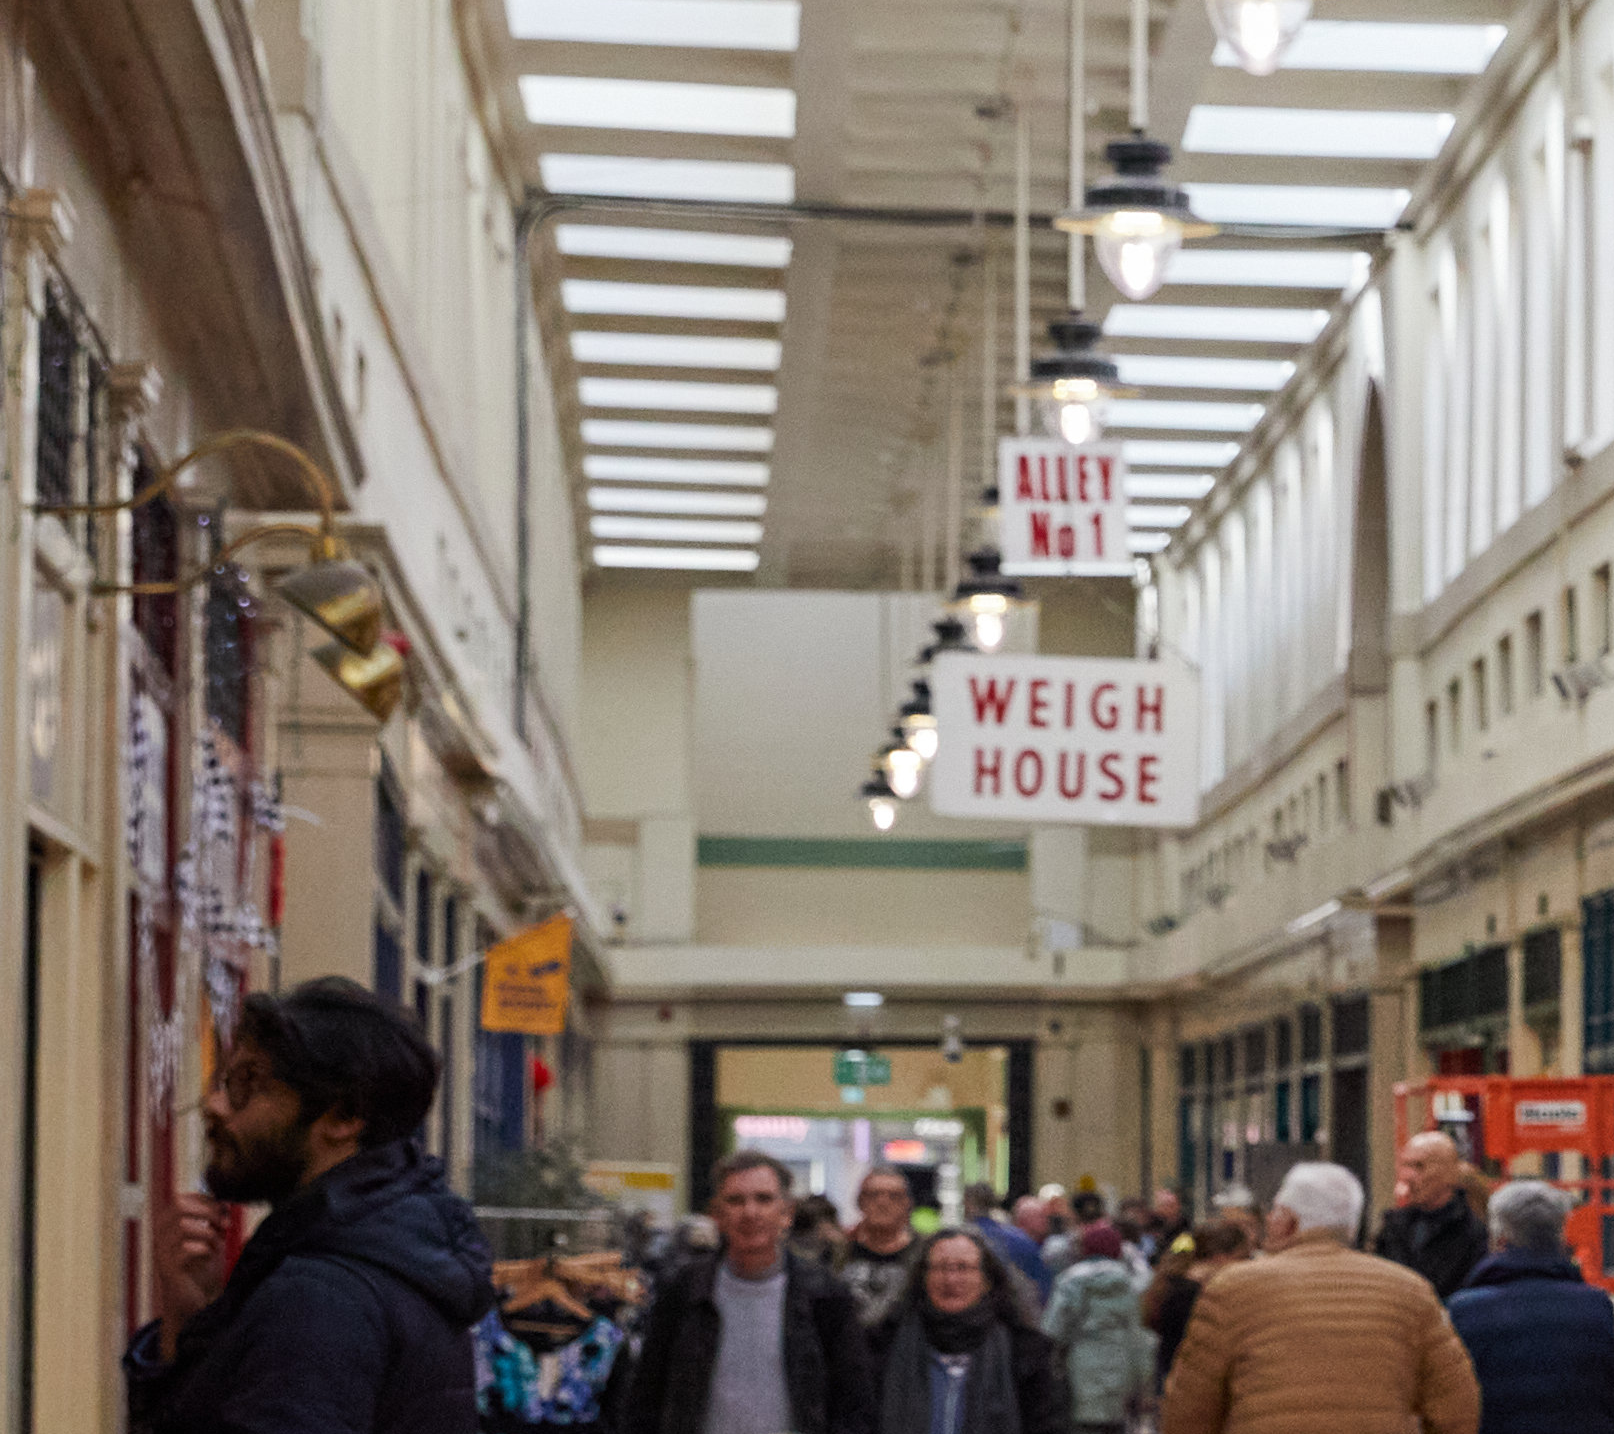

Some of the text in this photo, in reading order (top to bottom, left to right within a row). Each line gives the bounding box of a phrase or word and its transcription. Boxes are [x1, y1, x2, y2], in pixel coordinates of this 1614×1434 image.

[1015, 454, 1114, 503] ALLEY
[968, 675, 1165, 734] WEIGH
[972, 747, 1162, 805] HOUSE
